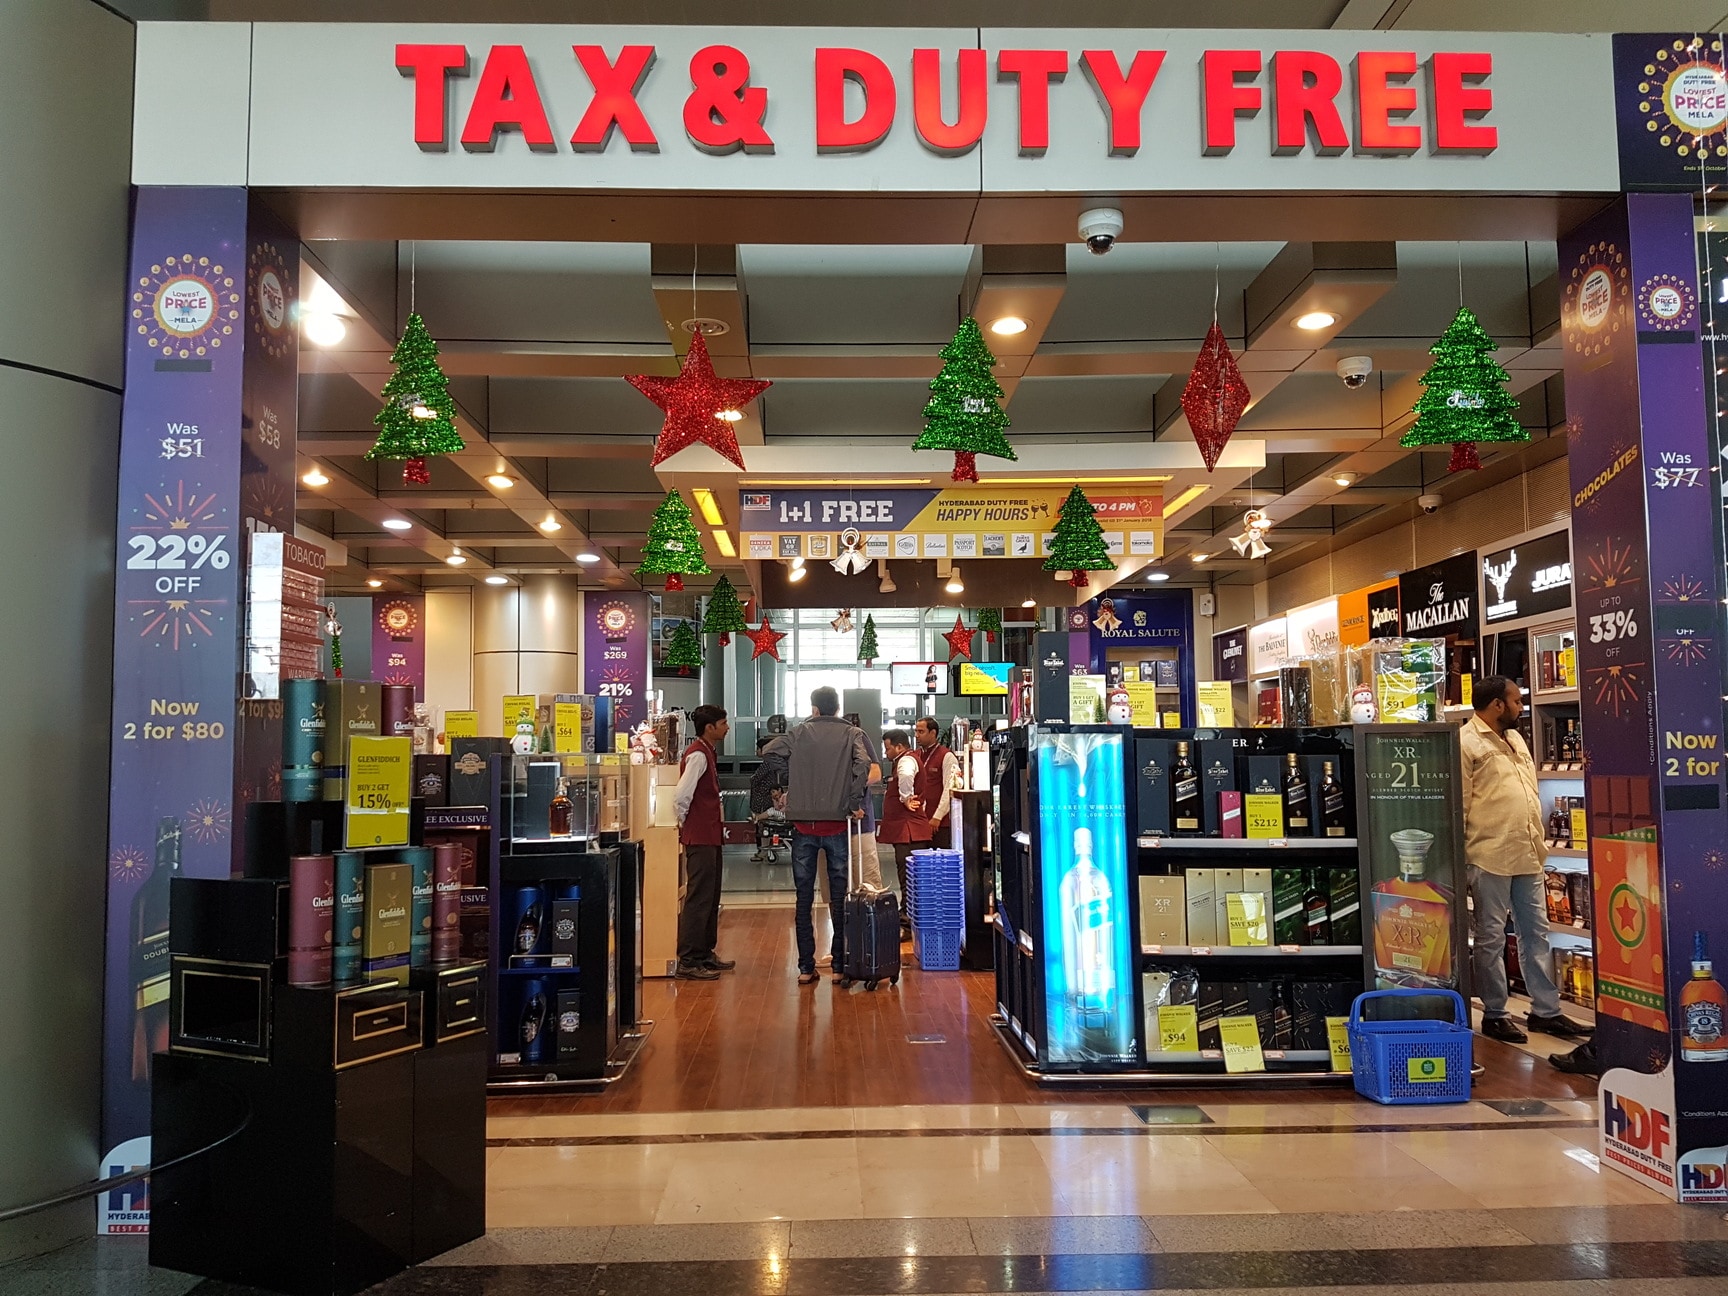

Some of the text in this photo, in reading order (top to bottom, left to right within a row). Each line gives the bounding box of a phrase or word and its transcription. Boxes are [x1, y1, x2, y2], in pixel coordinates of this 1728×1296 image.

[396, 44, 1498, 157] TAX & DUTY FREE
[172, 290, 200, 298] LOWEST
[263, 405, 278, 424] Was
[167, 423, 199, 434] Was
[161, 437, 203, 459] $51
[1660, 452, 1692, 464] Was
[1574, 444, 1638, 507] CHOCOLATES
[1655, 467, 1700, 489] $77
[745, 496, 893, 522] HDF 1+1 FREE
[936, 507, 1029, 521] HAPPY HOURS
[1109, 503, 1117, 511] 4
[1118, 502, 1136, 511] PM
[126, 535, 230, 570] 22%
[285, 541, 326, 570] TOBACCO
[1531, 562, 1572, 589] JURA
[155, 576, 201, 594] OFF
[1428, 581, 1445, 605] The
[1600, 596, 1621, 608] UP TO
[1406, 597, 1470, 633] MACALLAN
[1101, 628, 1181, 638] ROYAL SALUTE
[1590, 608, 1637, 644] 33%
[603, 651, 627, 660] $269
[1606, 647, 1620, 657] OFF
[388, 658, 407, 667] $94
[599, 683, 633, 697] 21%
[150, 699, 200, 716] Now
[250, 701, 264, 718] for
[268, 701, 283, 719] $9
[123, 721, 225, 741] 2 for $80
[559, 727, 573, 736] $64
[1666, 731, 1717, 749] Now
[357, 755, 400, 763] GLENFIDDICH
[1666, 757, 1720, 776] 2 for
[1391, 762, 1421, 788] 21
[358, 793, 391, 809] 15%
[439, 815, 488, 823] EXCLUSIVE
[1254, 818, 1278, 827] $212
[1403, 955, 1411, 963] 21
[1168, 1033, 1186, 1042] $94
[1604, 1089, 1670, 1159] HDF
[1605, 1136, 1673, 1174] HYDERABAD DUTY FREE
[1606, 1149, 1672, 1187] BEST PRICES ALWAYS
